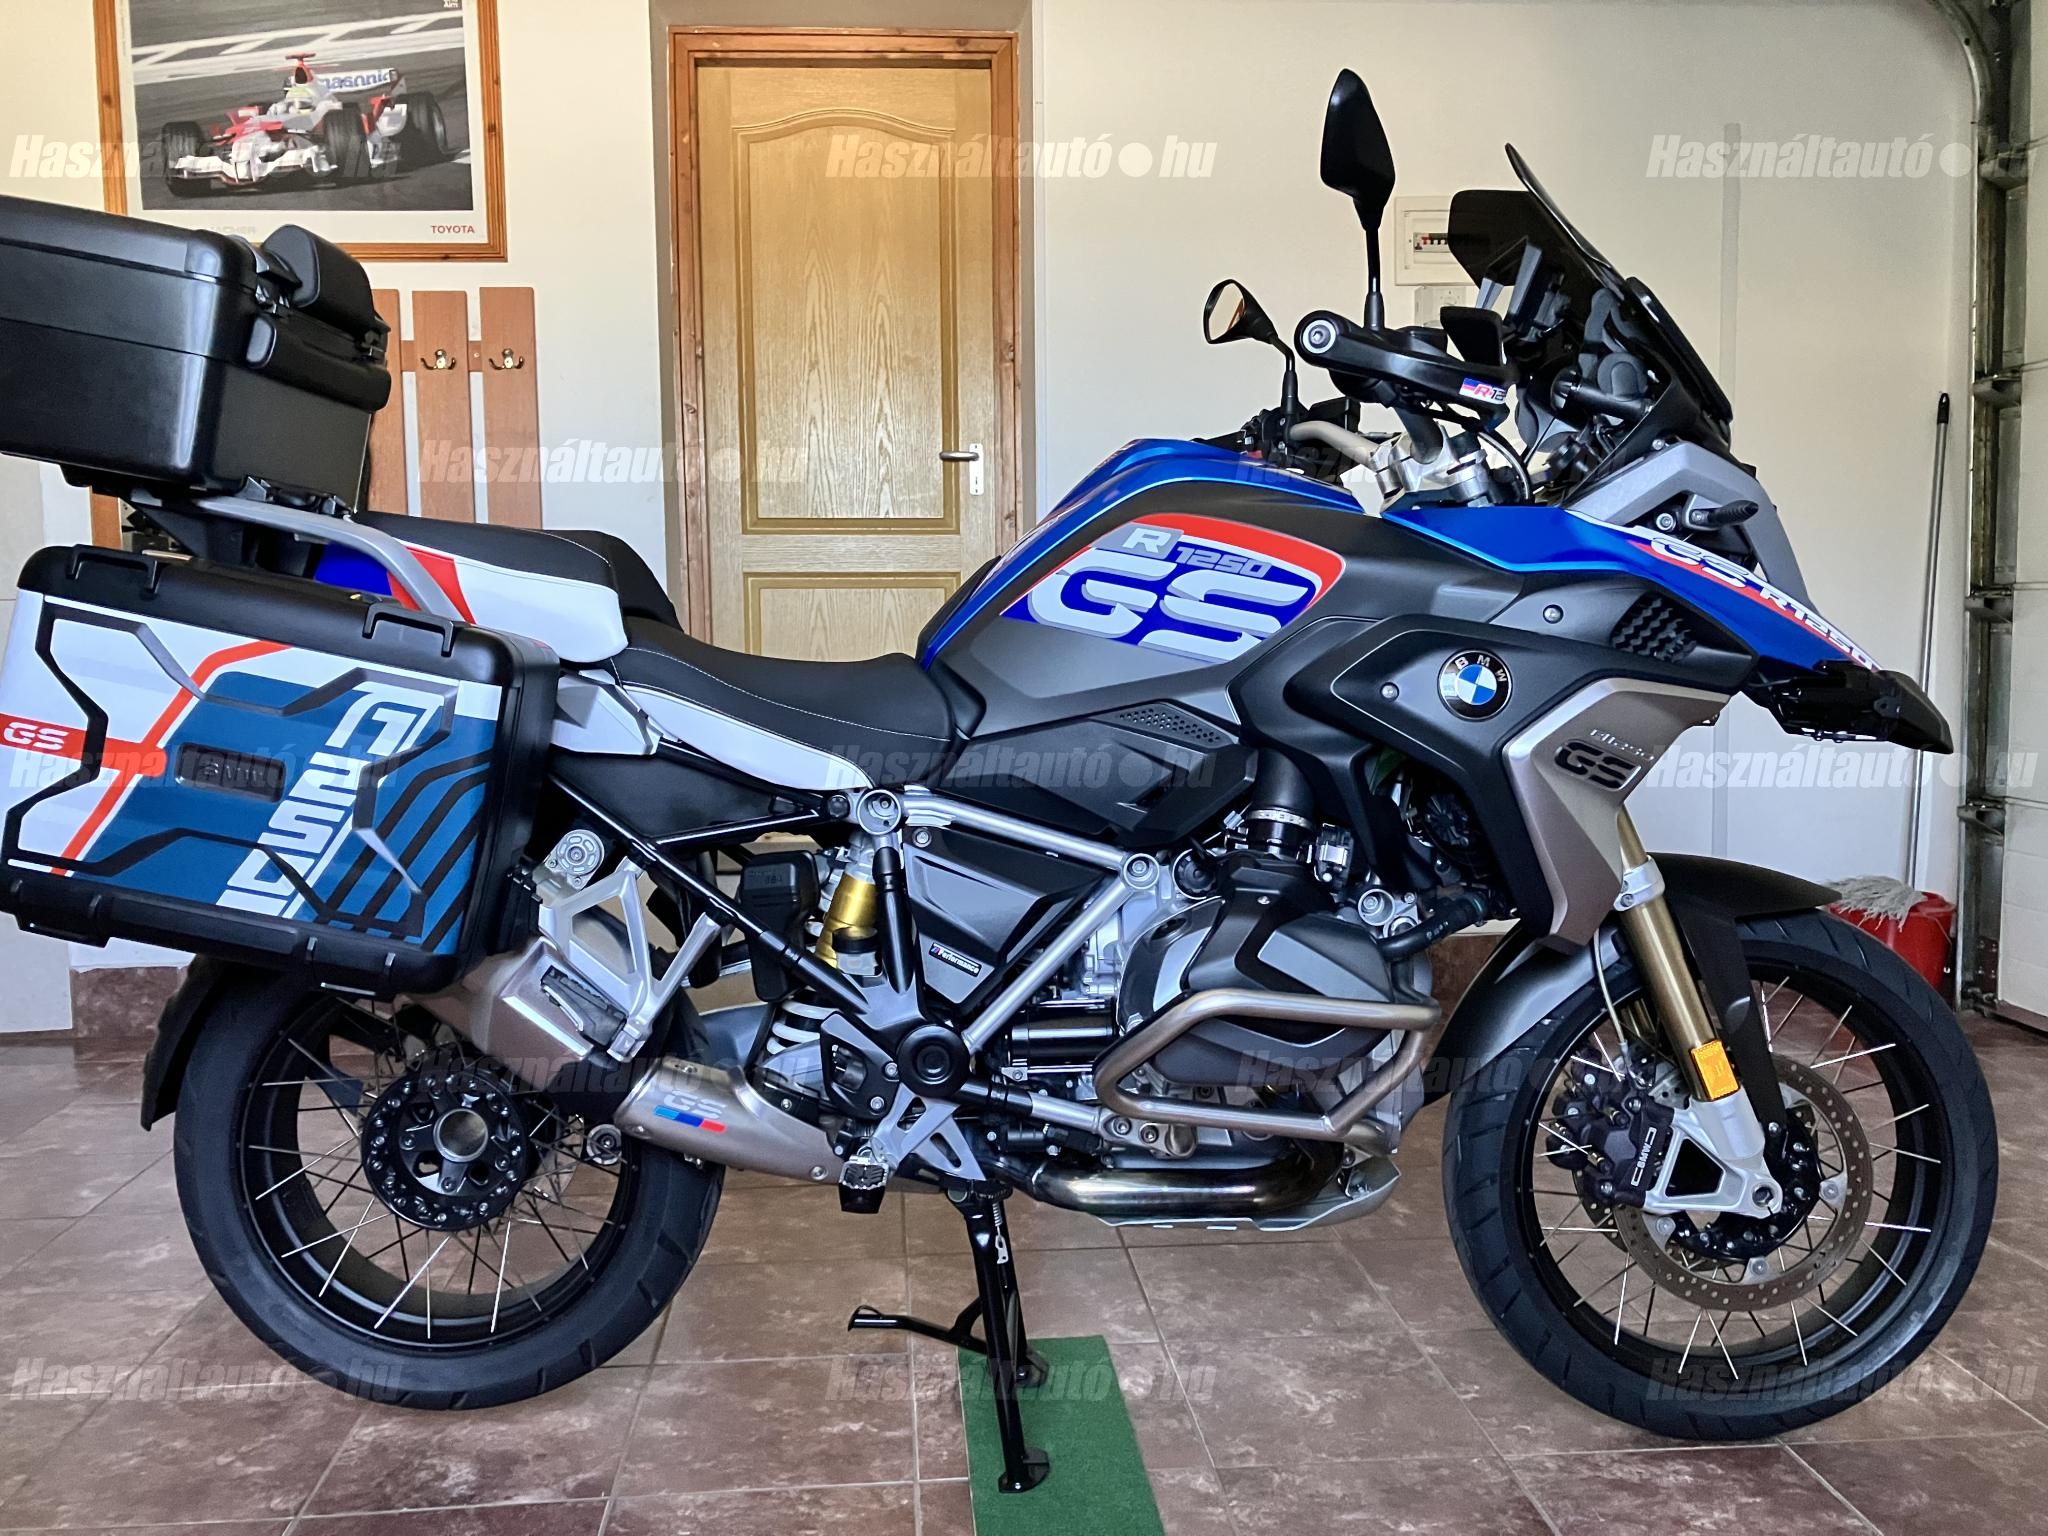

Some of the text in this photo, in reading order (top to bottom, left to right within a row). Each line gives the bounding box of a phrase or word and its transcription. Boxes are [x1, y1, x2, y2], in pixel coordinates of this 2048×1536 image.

[431, 224, 475, 234] TOYOTA
[1123, 528, 1272, 578] R 1250
[1651, 538, 1750, 588] GS
[1028, 548, 1309, 662] GS
[1455, 655, 1507, 682] BMW
[4, 721, 69, 751] GS
[1554, 741, 1640, 790] GS
[663, 1089, 728, 1120] GS
